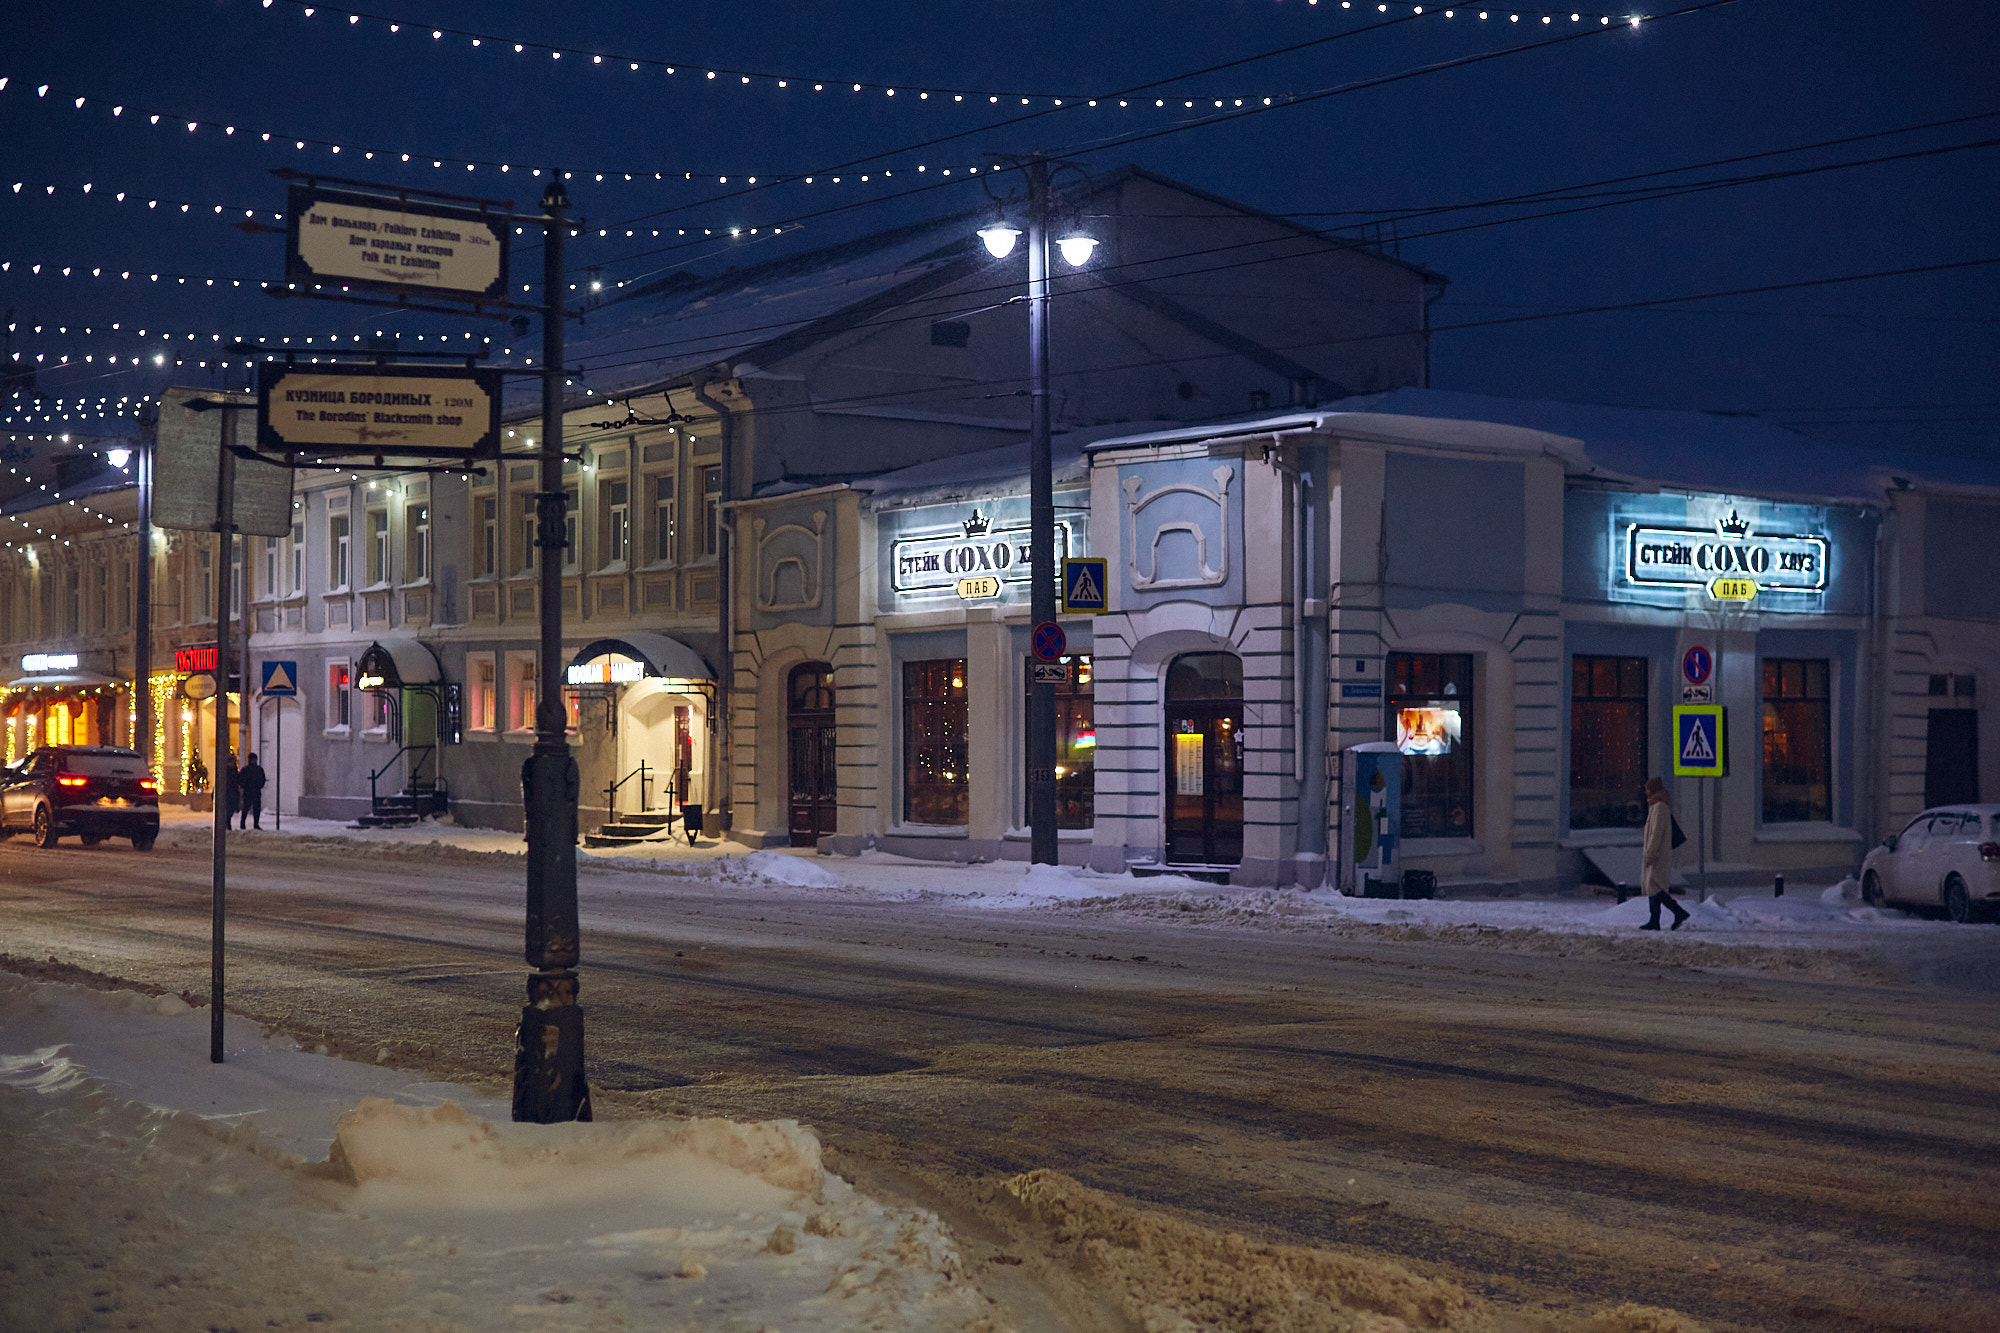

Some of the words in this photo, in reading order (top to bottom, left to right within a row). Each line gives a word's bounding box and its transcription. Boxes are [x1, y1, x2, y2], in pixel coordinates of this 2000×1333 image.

[310, 213, 327, 225] Дом
[421, 227, 461, 242] Exhibition
[349, 234, 367, 246] Дом
[371, 239, 412, 252] народных
[416, 244, 453, 257] мастеров
[362, 251, 379, 263] Folk
[384, 254, 397, 265] Art
[401, 255, 440, 270] Exhibition
[285, 389, 345, 403] КУЗНИЦА
[350, 391, 432, 406] БОРОДИНЫХ
[296, 409, 315, 421] The
[374, 412, 433, 425] Blacksmith
[436, 414, 463, 427] shop
[900, 551, 940, 575] СТЕЙК
[944, 542, 1012, 574] СОХО
[1638, 541, 1692, 567] СТЕЙК
[1695, 543, 1770, 574] СОХО
[1776, 551, 1815, 573] ХАУЗ
[966, 580, 988, 595] ПАБ
[1723, 582, 1747, 596] ПАБ
[175, 648, 219, 672] ГОСТИНИЦ
[610, 661, 645, 683] MARKET
